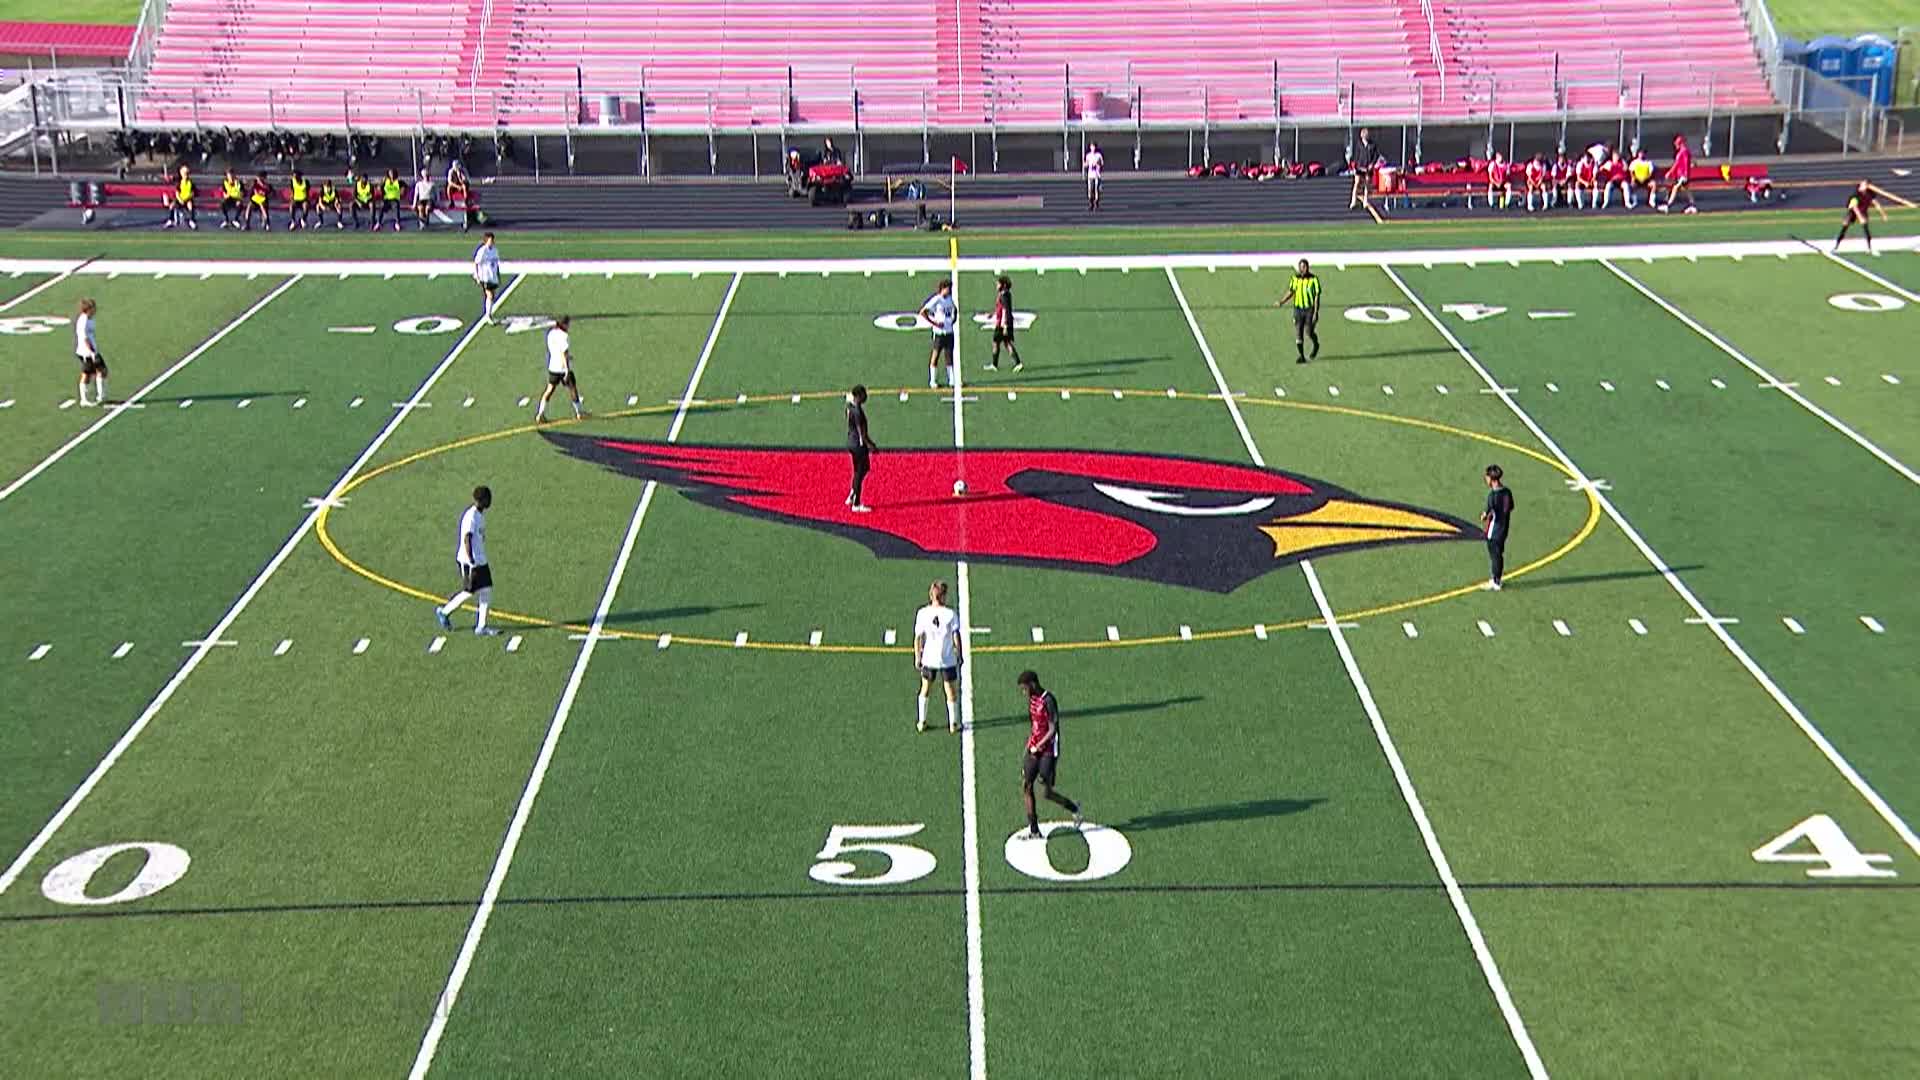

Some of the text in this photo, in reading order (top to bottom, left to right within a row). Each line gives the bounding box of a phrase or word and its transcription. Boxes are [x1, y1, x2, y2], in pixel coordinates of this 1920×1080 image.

[932, 615, 940, 629] 4
[41, 841, 191, 905] 0
[1751, 814, 1899, 878] 4
